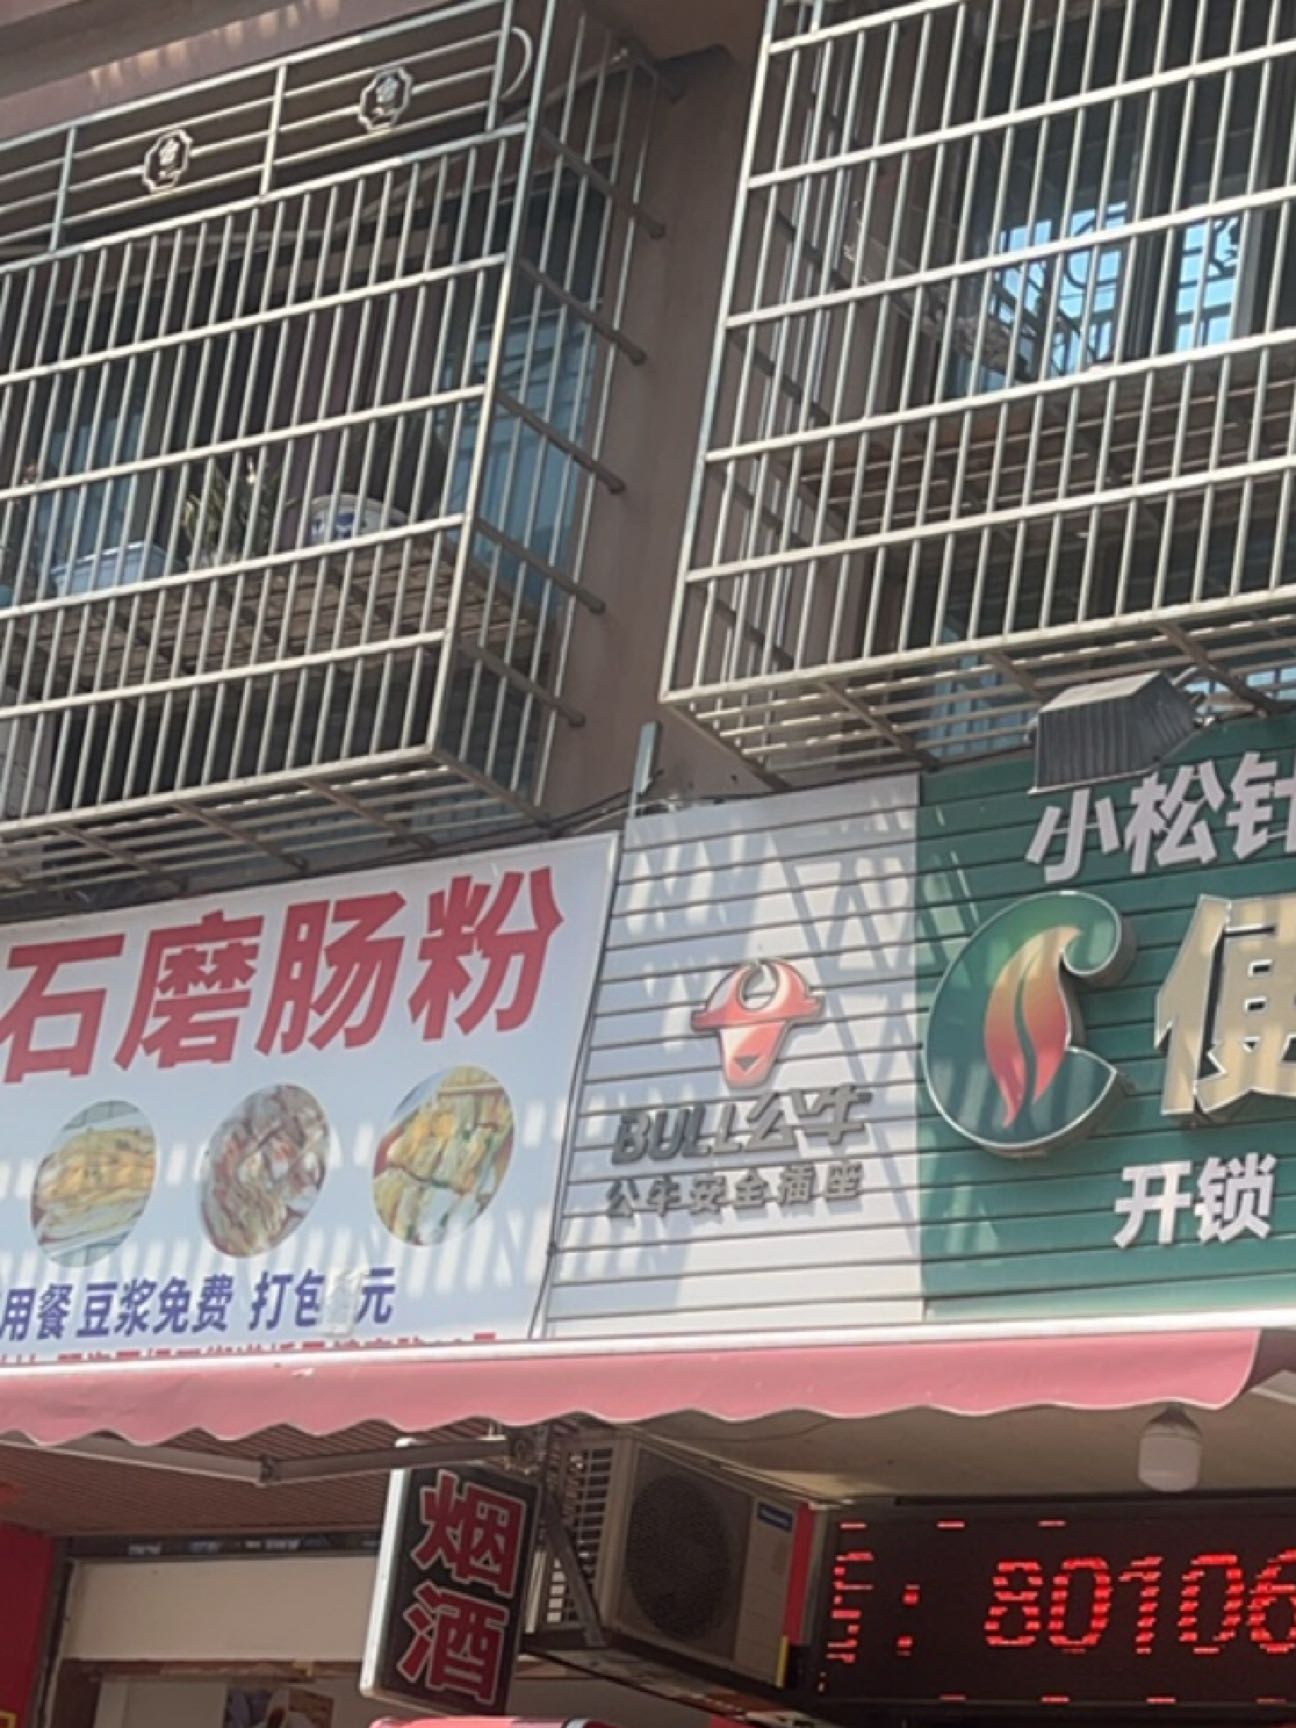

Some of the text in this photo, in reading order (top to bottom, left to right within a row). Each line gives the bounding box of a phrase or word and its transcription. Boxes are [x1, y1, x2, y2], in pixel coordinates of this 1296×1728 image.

[0, 866, 564, 1084] 石磨肠粉
[1113, 1155, 1277, 1249] 开锁
[249, 1267, 397, 1331] 打包元
[398, 1468, 526, 1704] 烟酒
